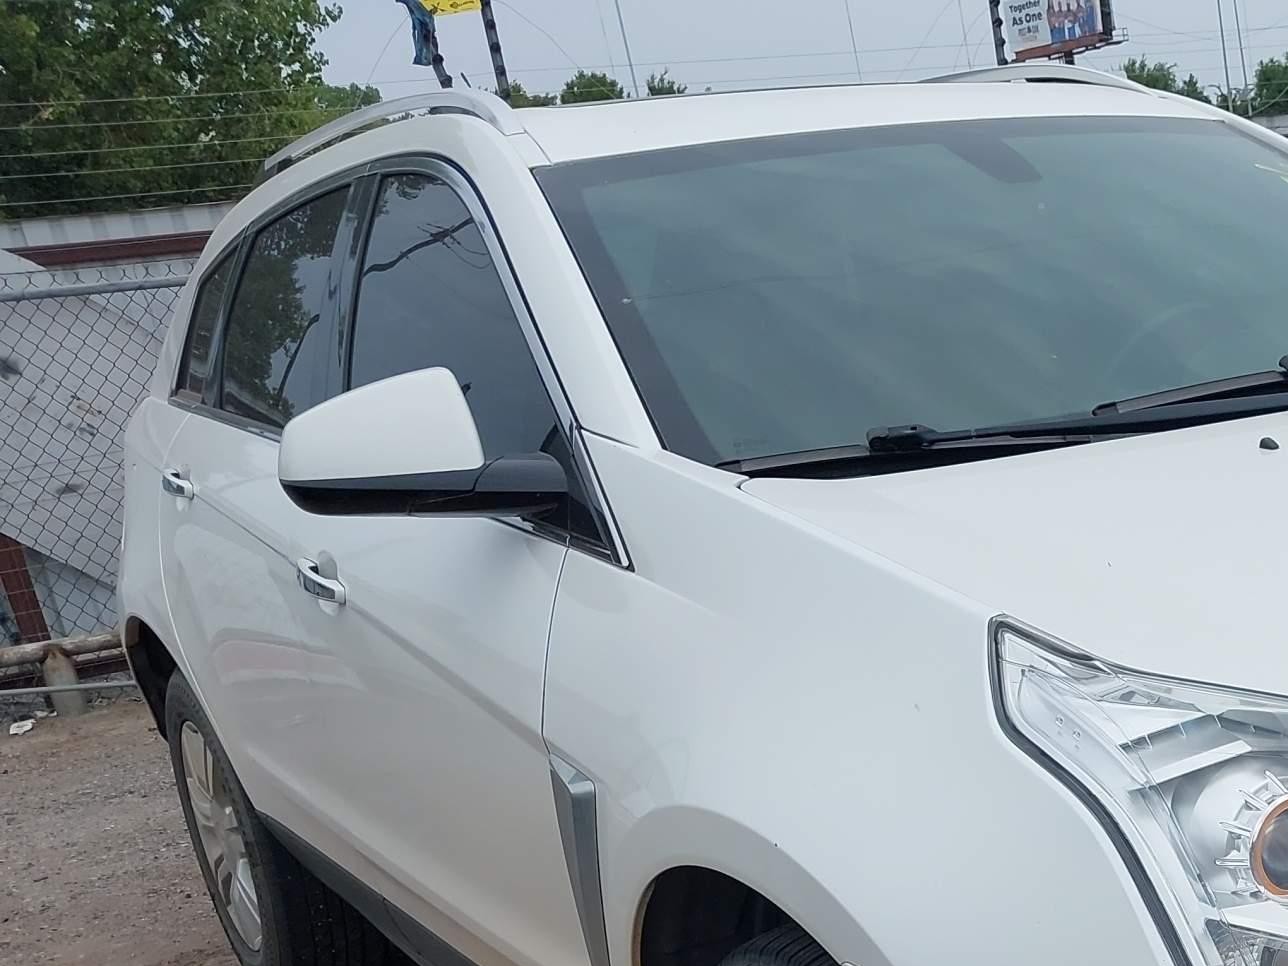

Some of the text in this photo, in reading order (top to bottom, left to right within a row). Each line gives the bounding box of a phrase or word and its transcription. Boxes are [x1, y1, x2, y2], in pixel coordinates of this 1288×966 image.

[1009, 0, 1041, 13] Together
[1012, 11, 1043, 27] As One
